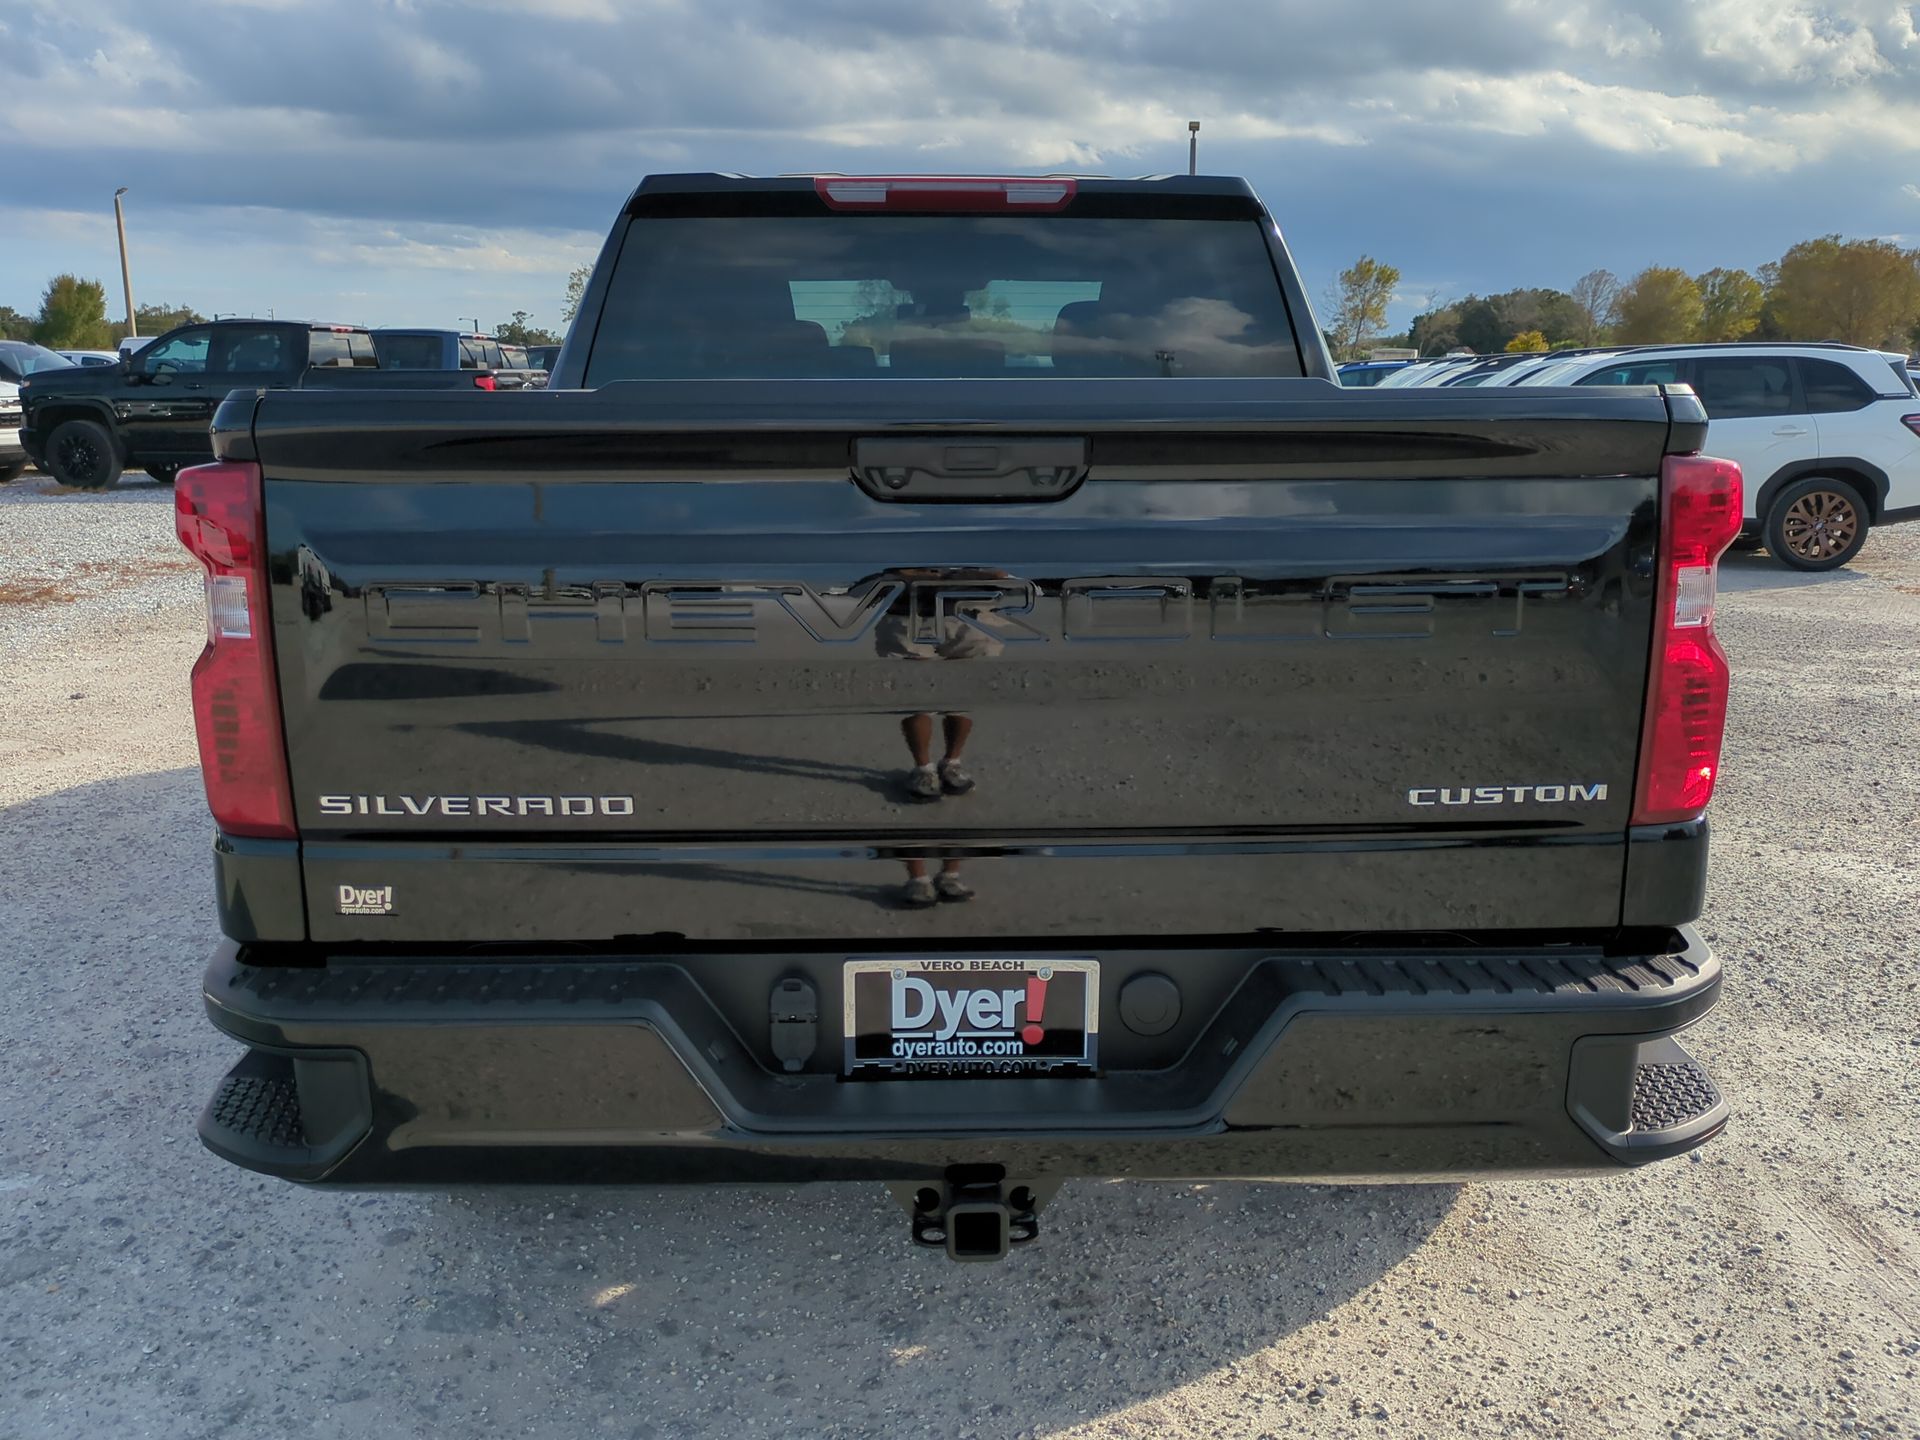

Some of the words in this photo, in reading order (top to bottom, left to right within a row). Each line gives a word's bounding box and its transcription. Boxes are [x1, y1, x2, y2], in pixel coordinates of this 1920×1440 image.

[362, 573, 1568, 644] CHEVROLET
[319, 795, 635, 816] SILVERADO
[1408, 783, 1608, 806] CUSTOM
[340, 885, 392, 910] Dyer!
[341, 907, 386, 915] dyerauto.com
[920, 960, 965, 971] VERO
[970, 960, 1025, 971] BEACH
[891, 976, 1048, 1045] Dyer!
[892, 1038, 1024, 1060] dyerauto.com
[905, 1060, 1038, 1075] DYERAUTO.COM
